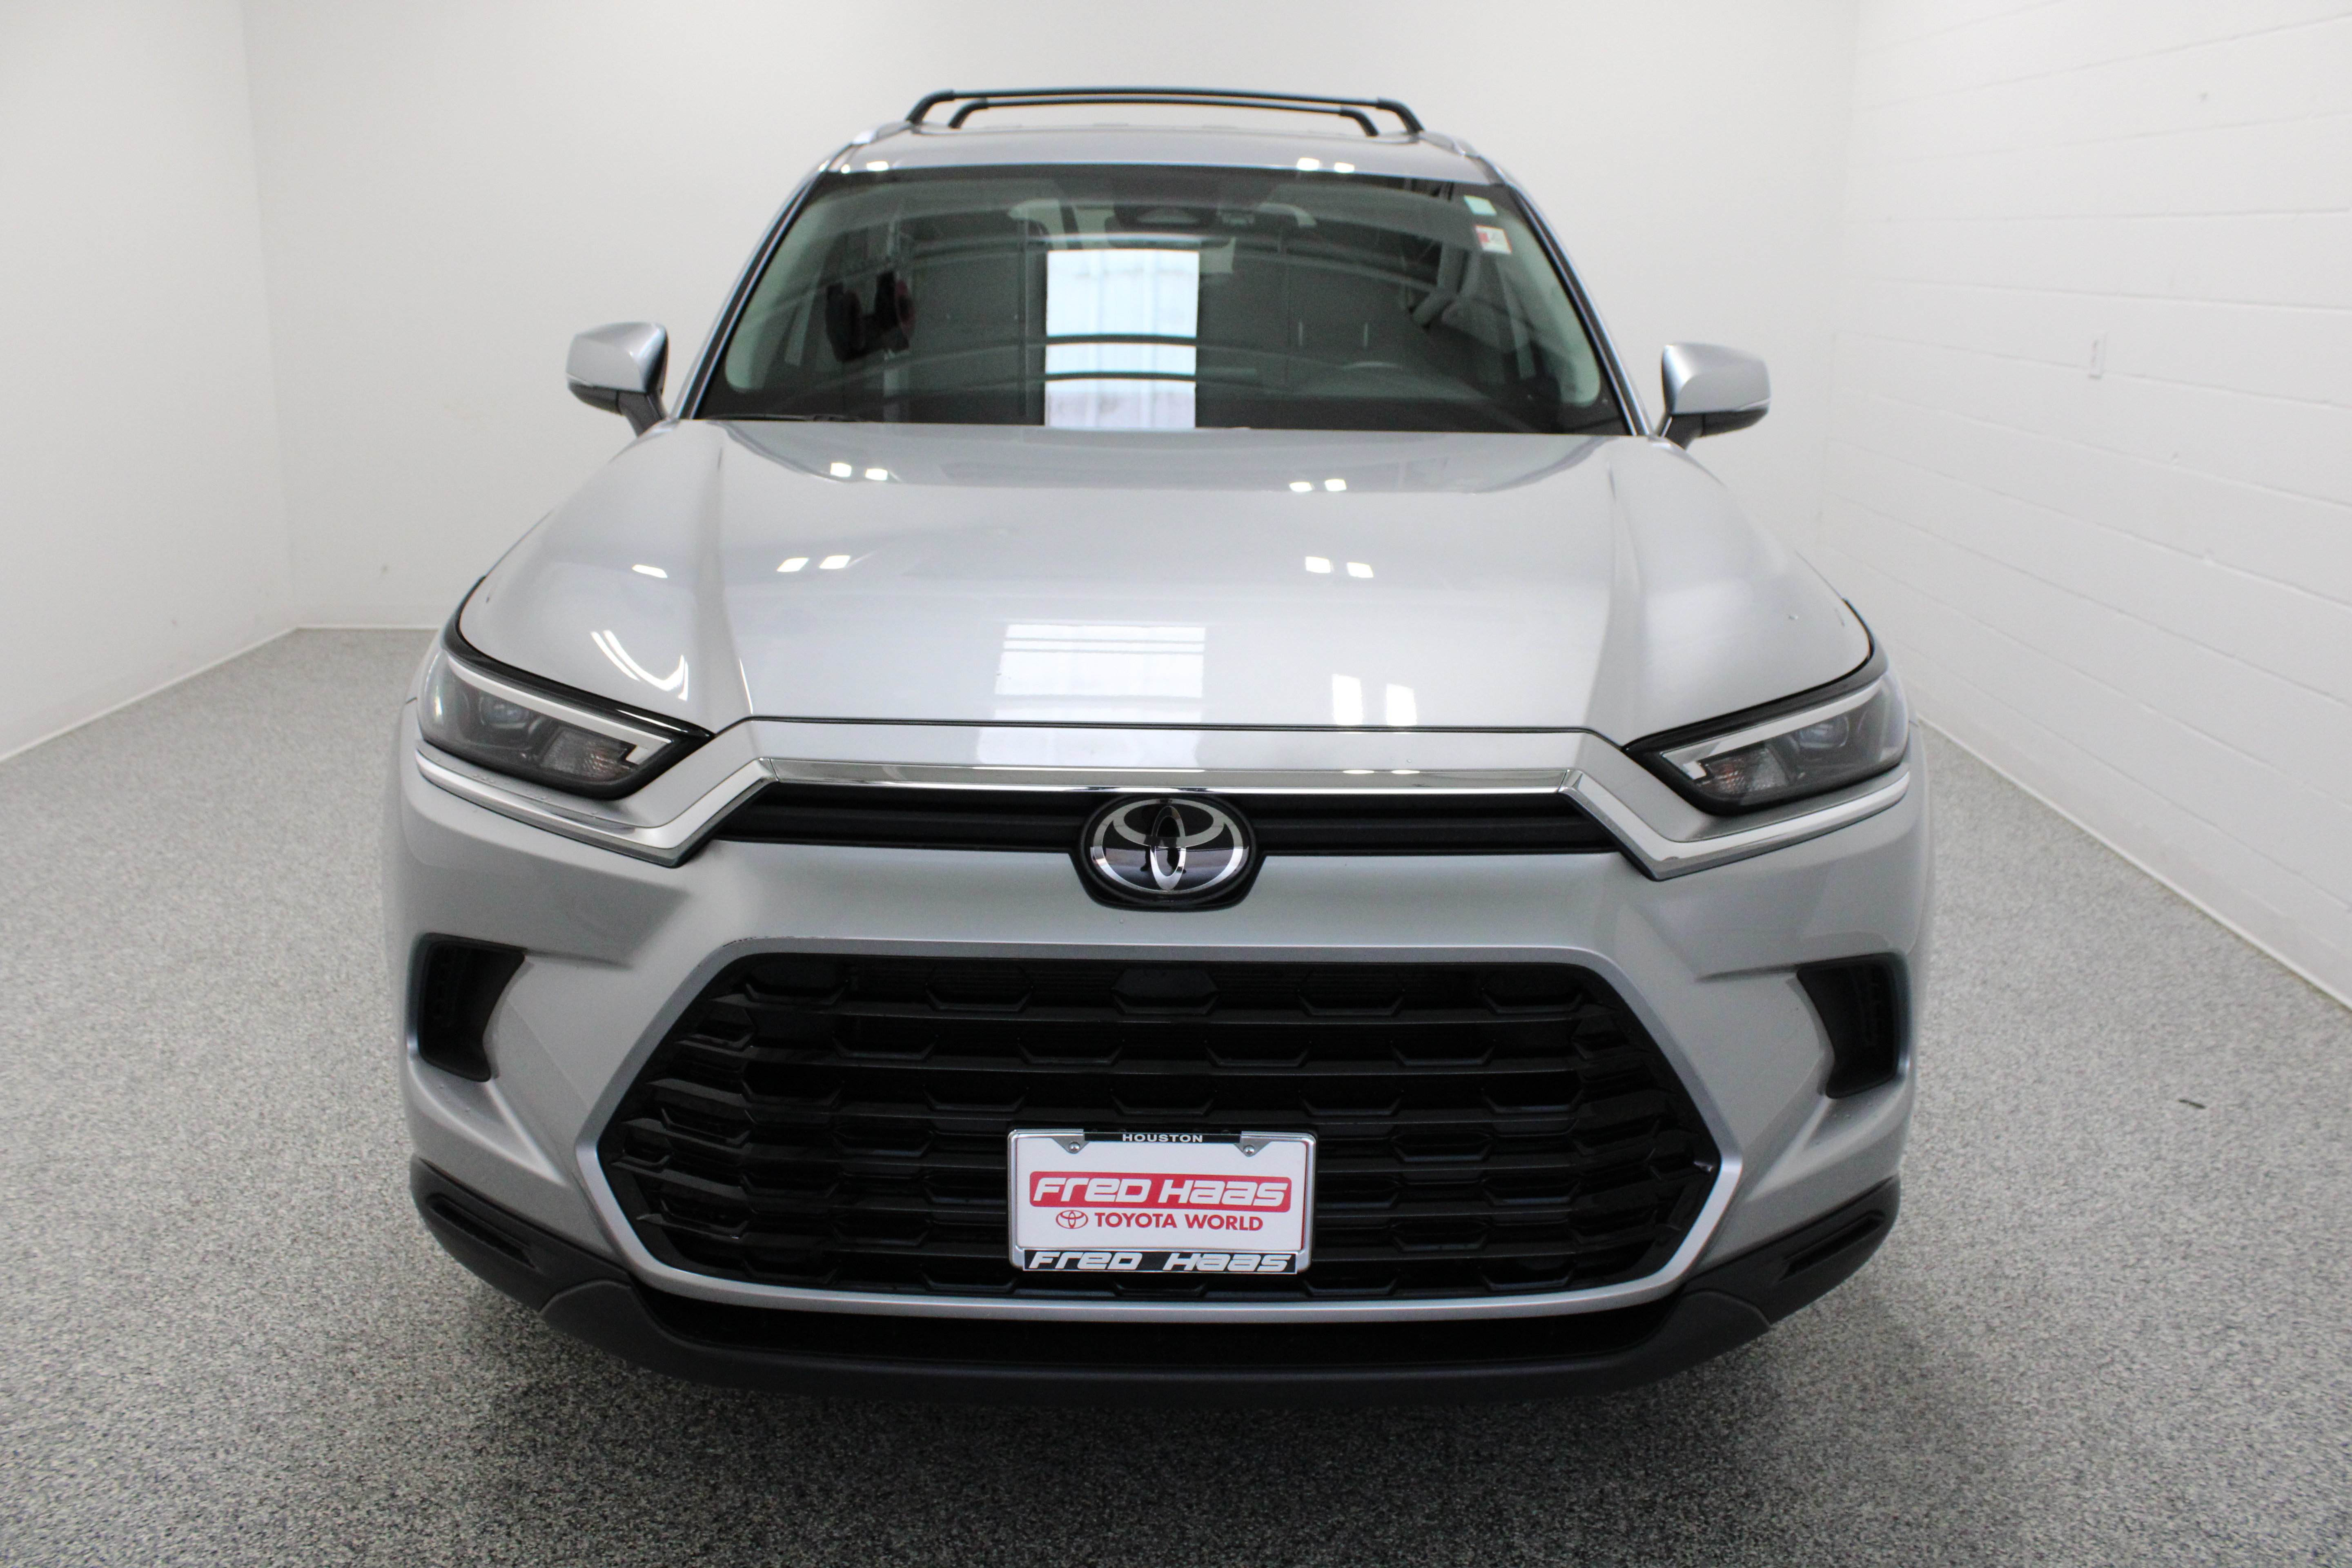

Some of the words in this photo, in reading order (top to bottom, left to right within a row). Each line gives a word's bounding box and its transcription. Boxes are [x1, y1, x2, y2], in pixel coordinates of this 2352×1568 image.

[1122, 1134, 1203, 1143] HOUSTON
[1095, 1212, 1178, 1228] TOYOTA
[1185, 1214, 1263, 1231] WORLD
